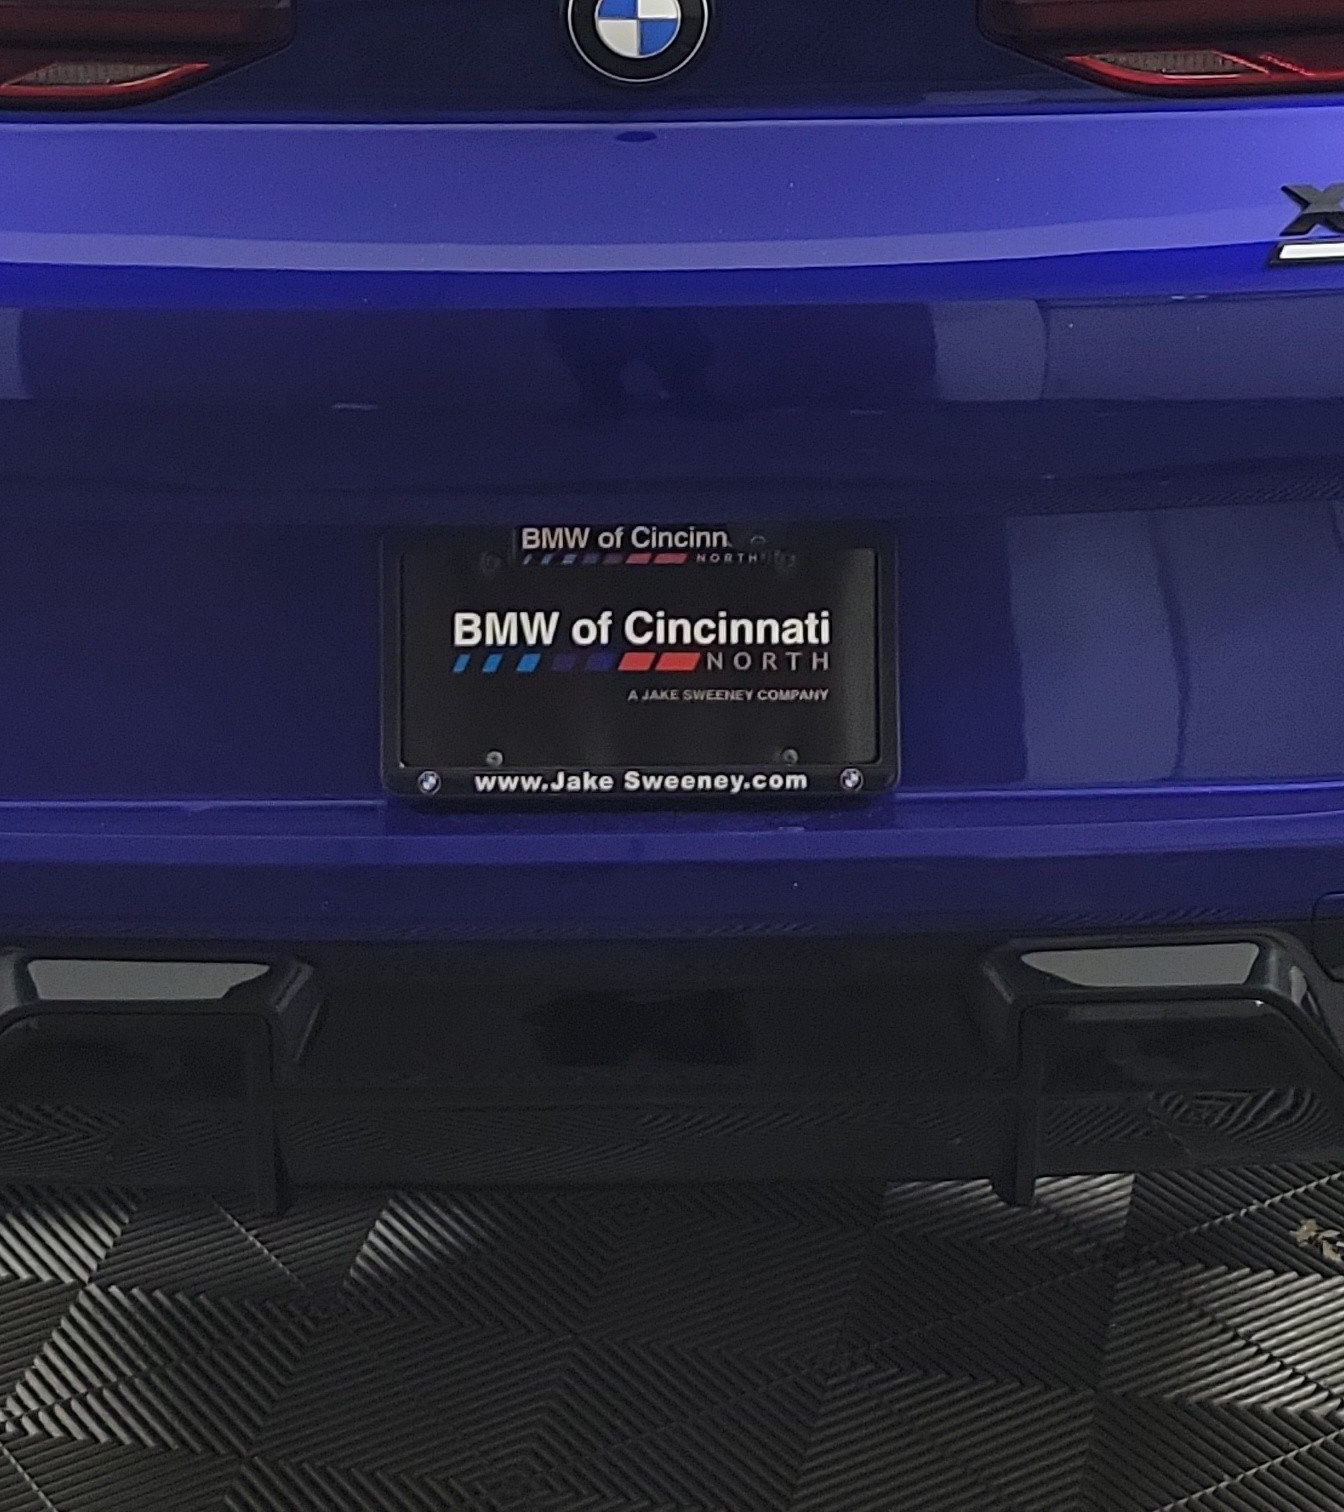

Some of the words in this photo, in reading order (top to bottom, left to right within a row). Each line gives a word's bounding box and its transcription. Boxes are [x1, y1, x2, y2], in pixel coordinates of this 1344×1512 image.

[522, 527, 590, 549] BMW
[598, 526, 624, 549] of
[631, 525, 732, 549] Cincinn
[695, 552, 758, 564] NORTH
[454, 611, 560, 646] BMW
[572, 611, 613, 646] of
[624, 610, 830, 646] Cincinnati
[706, 651, 830, 672] NORTH
[628, 689, 639, 702] A
[642, 689, 680, 702] JAKE
[683, 689, 754, 702] SWEENEY
[757, 688, 829, 702] COMPANY
[474, 771, 614, 792] www.Jake
[624, 770, 809, 795] Sweeney.com
